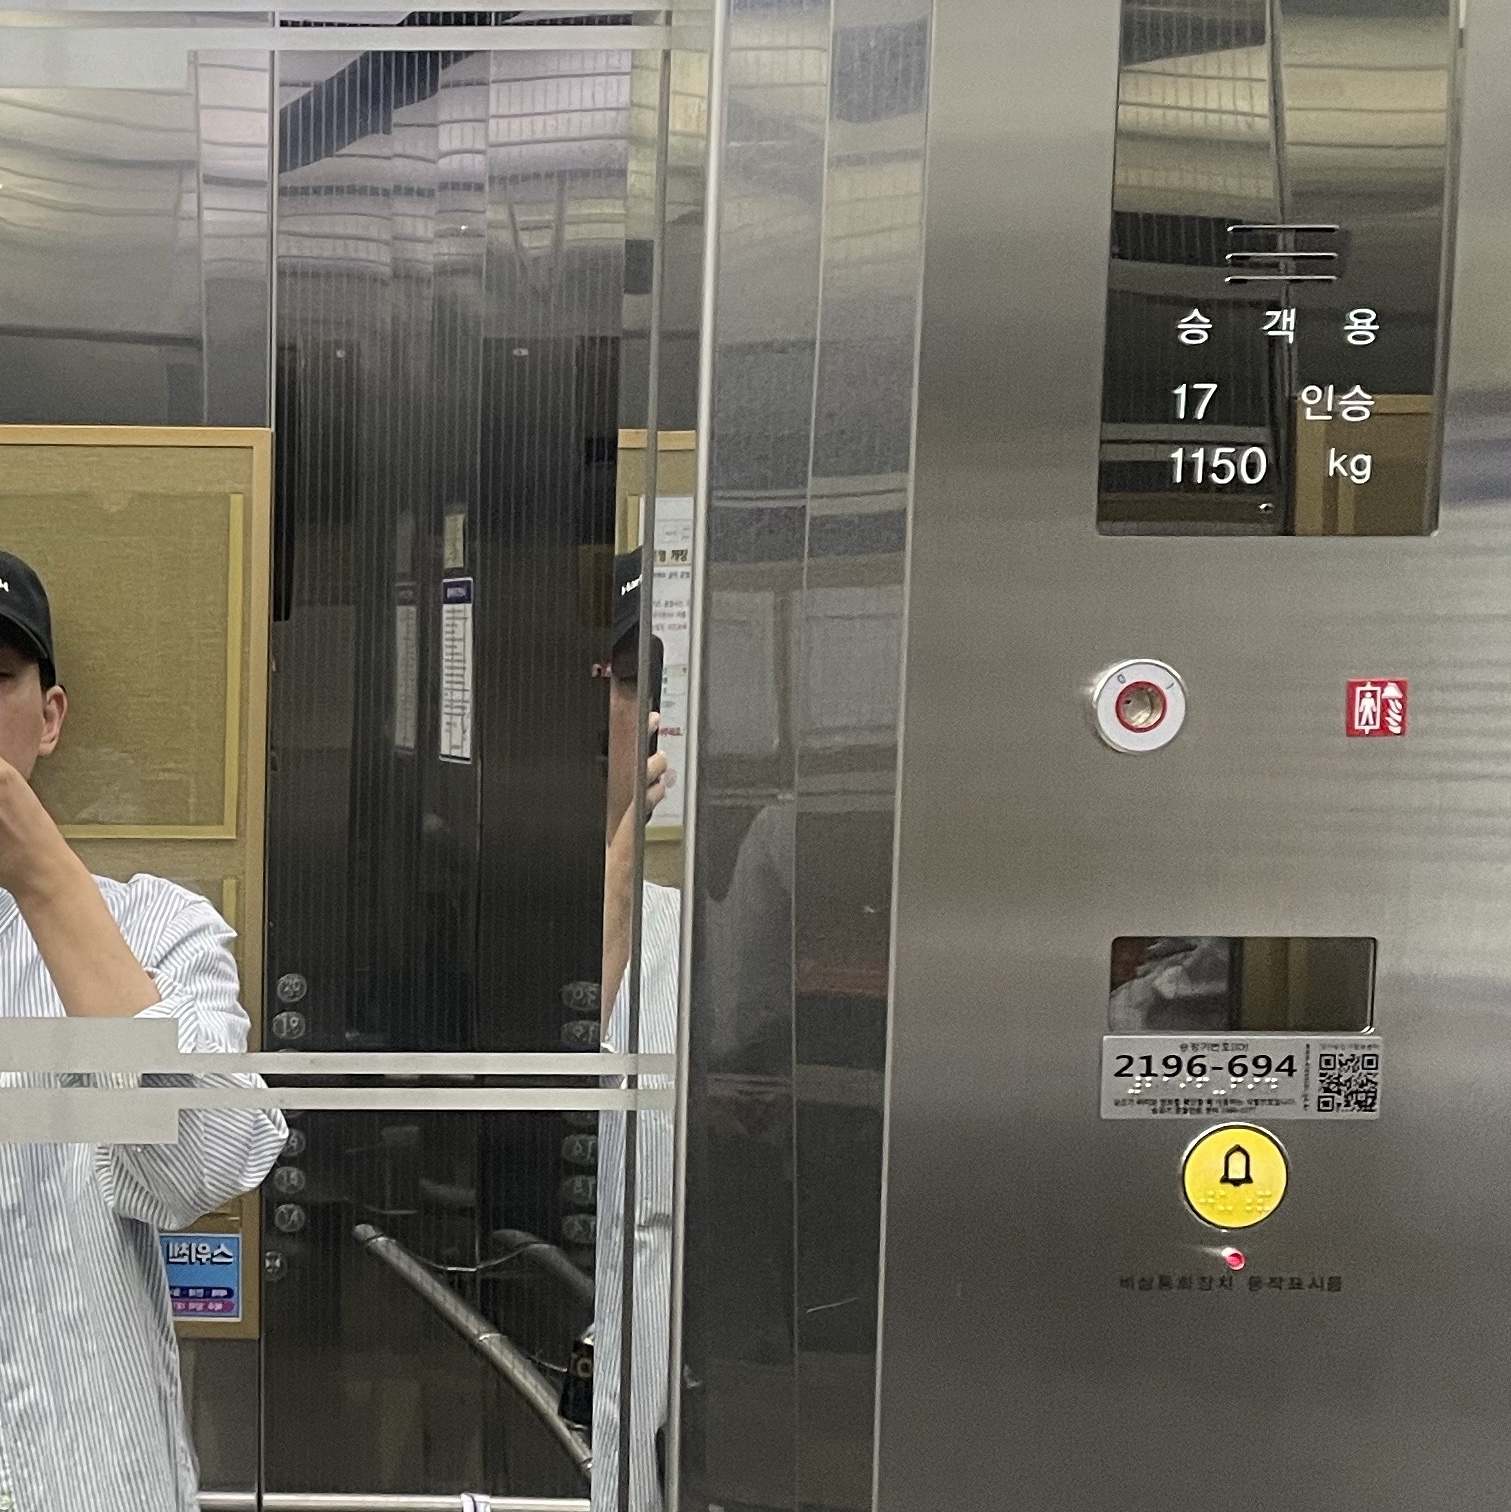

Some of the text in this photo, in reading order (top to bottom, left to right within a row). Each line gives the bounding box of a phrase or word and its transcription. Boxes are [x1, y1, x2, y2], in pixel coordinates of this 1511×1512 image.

[1172, 383, 1375, 422] 17 인승
[1170, 446, 1373, 485] 1150 kg
[1114, 1054, 1298, 1078] 2196-694
